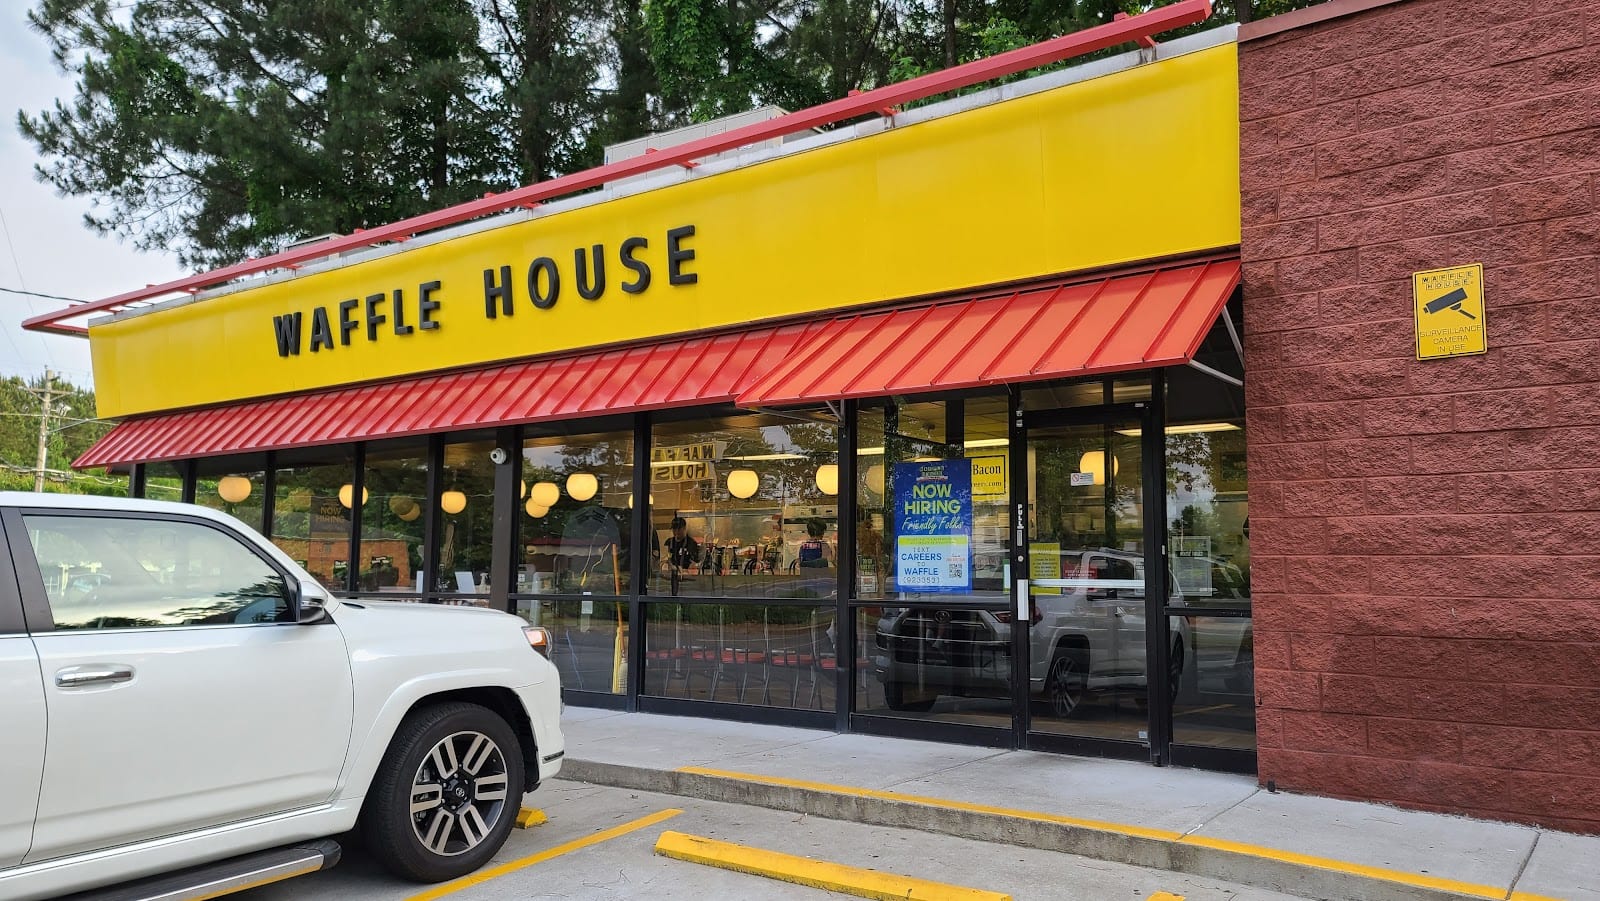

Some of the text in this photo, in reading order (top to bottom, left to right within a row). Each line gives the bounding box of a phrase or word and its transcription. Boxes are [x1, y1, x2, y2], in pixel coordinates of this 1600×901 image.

[1422, 270, 1473, 283] WAFFLE
[1426, 280, 1470, 290] HOUSE
[273, 225, 698, 357] WAFFLE HOUSE
[1420, 325, 1481, 337] SURVEILLANCE
[1433, 335, 1468, 345] CAMERA
[1448, 344, 1465, 352] USE
[972, 464, 1001, 475] Bacon
[913, 484, 952, 498] NOW
[320, 506, 341, 515] NOW
[904, 499, 961, 515] HIRING
[902, 516, 964, 534] Friendly Folks
[901, 553, 942, 561] CAREERS
